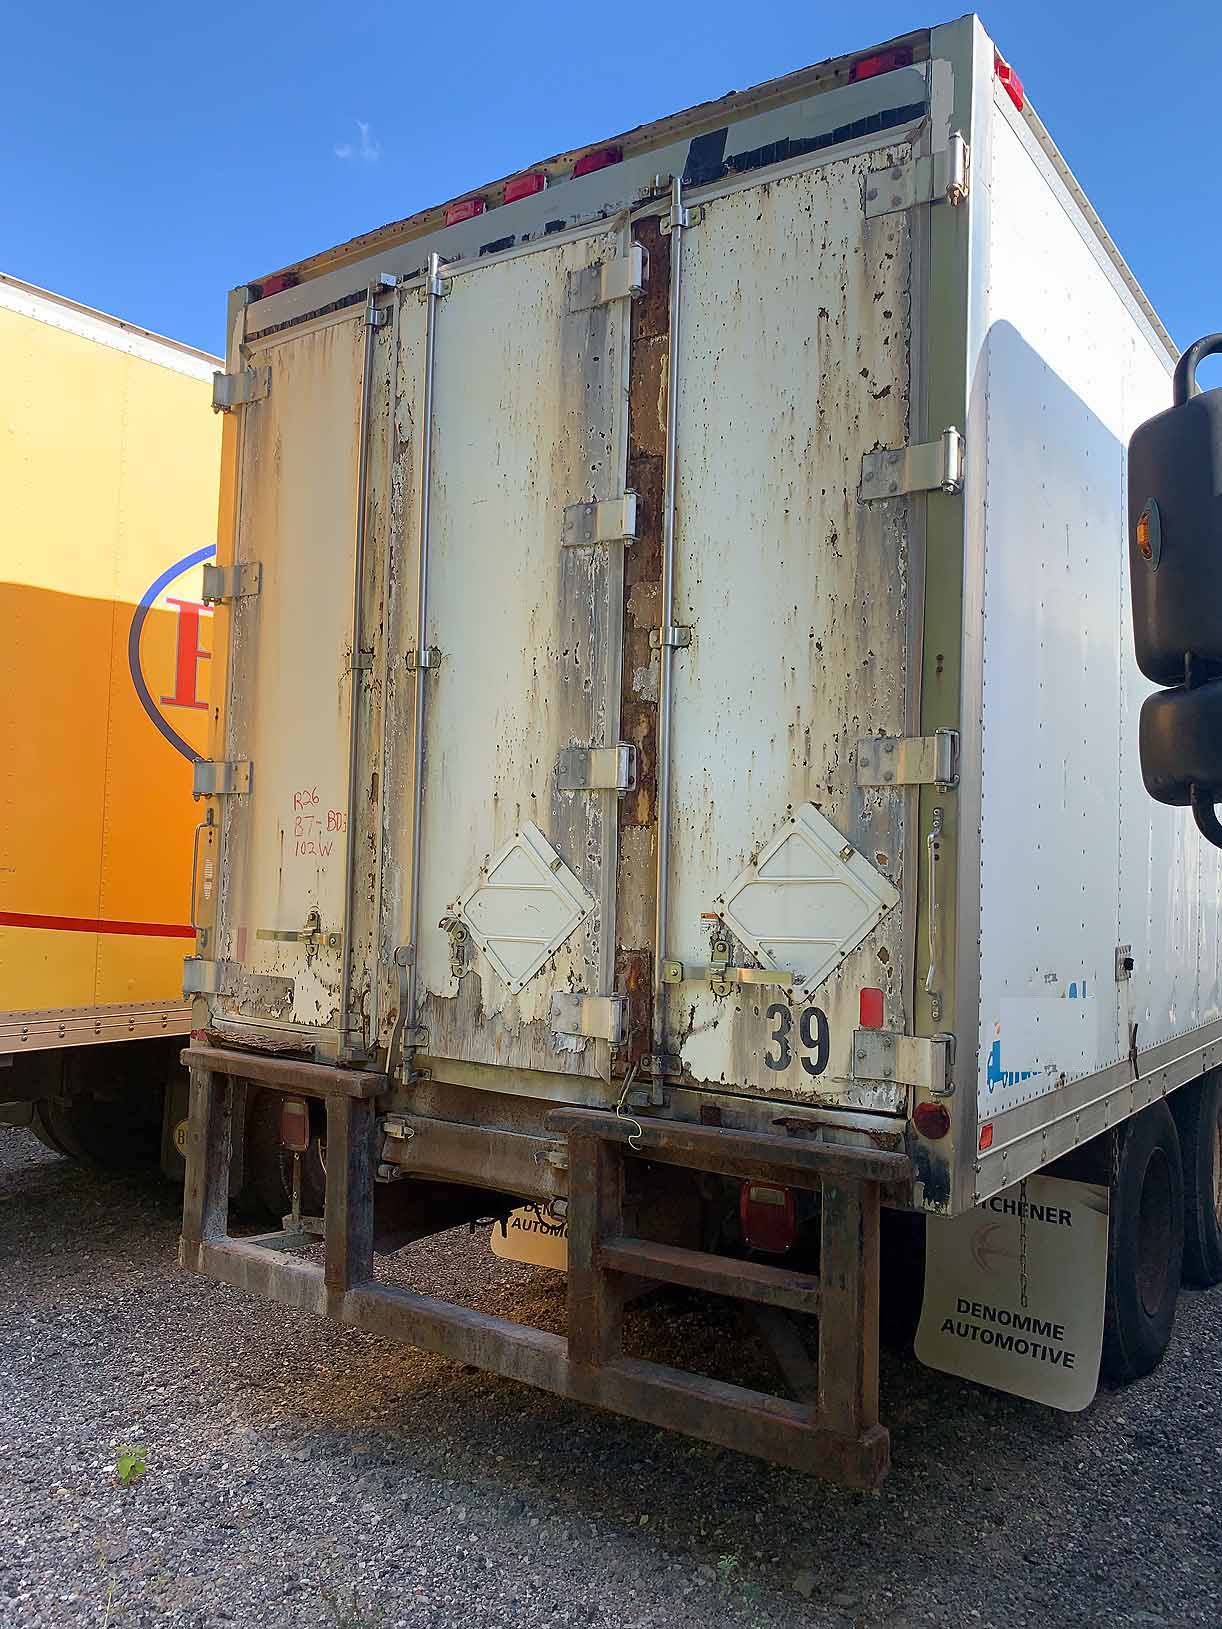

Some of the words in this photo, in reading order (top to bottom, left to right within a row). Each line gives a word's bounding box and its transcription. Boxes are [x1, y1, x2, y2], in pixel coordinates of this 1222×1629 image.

[293, 786, 320, 811] R26
[764, 1003, 830, 1076] 39
[957, 1298, 1065, 1341] DENOMME
[940, 1318, 1076, 1370] AUTOMOTIVE
